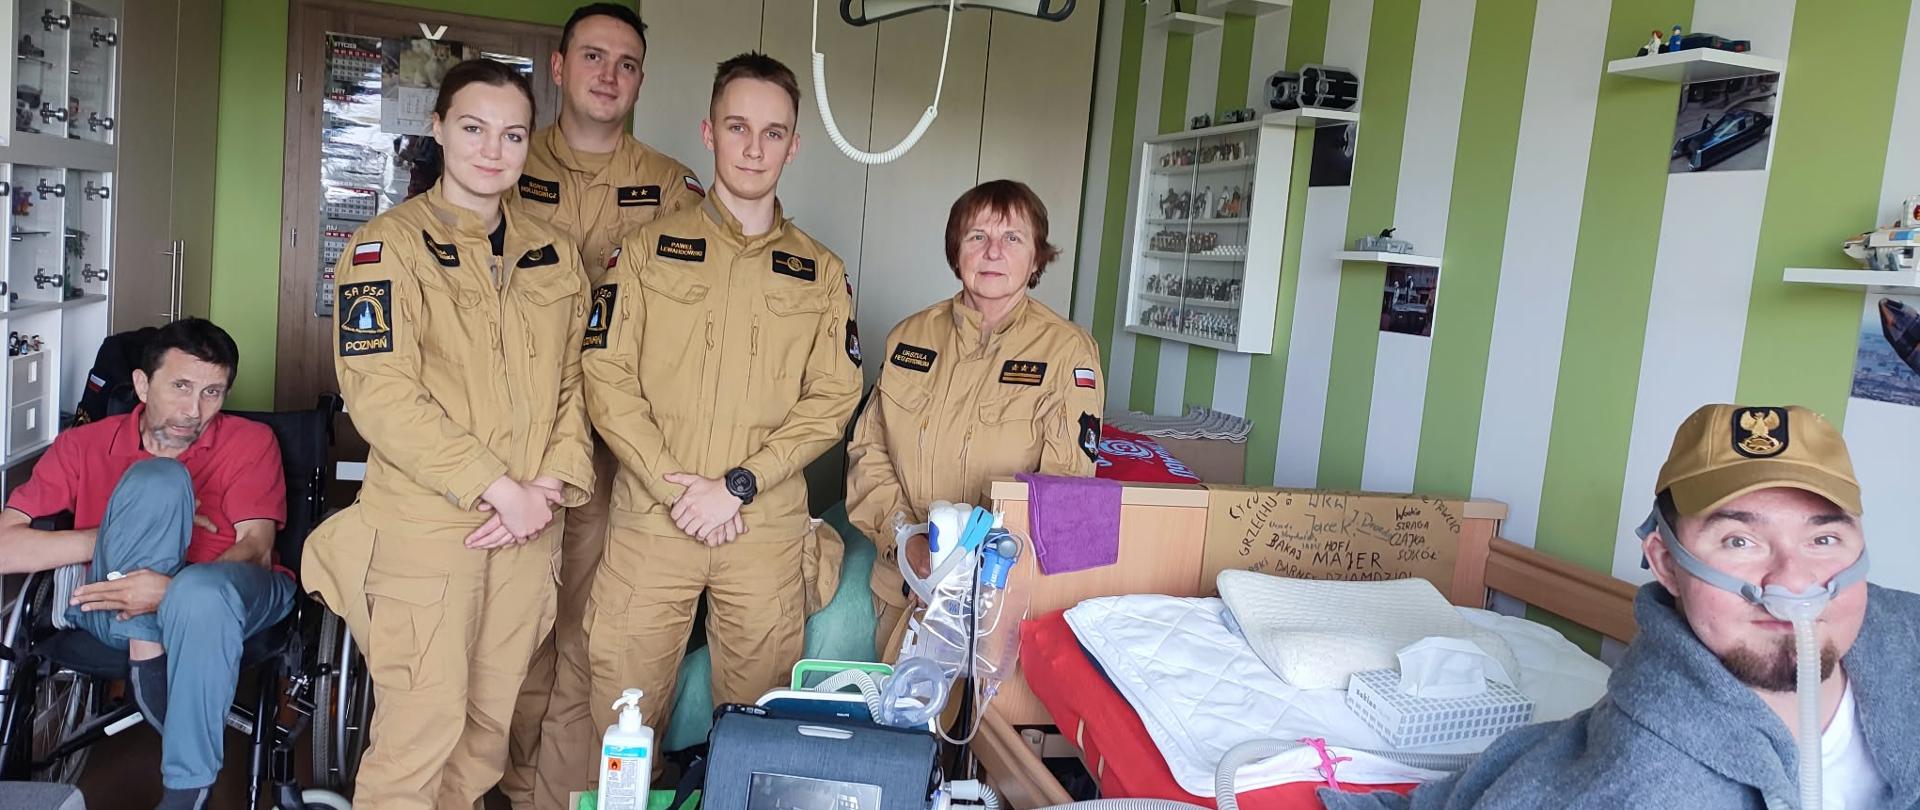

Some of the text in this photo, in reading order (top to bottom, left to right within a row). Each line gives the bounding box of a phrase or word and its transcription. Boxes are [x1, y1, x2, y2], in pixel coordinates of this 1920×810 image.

[344, 285, 385, 300] SA PSP
[345, 335, 388, 352] POZNAŃ
[1238, 495, 1278, 556] GRZECHU
[1312, 550, 1383, 572] MAJER
